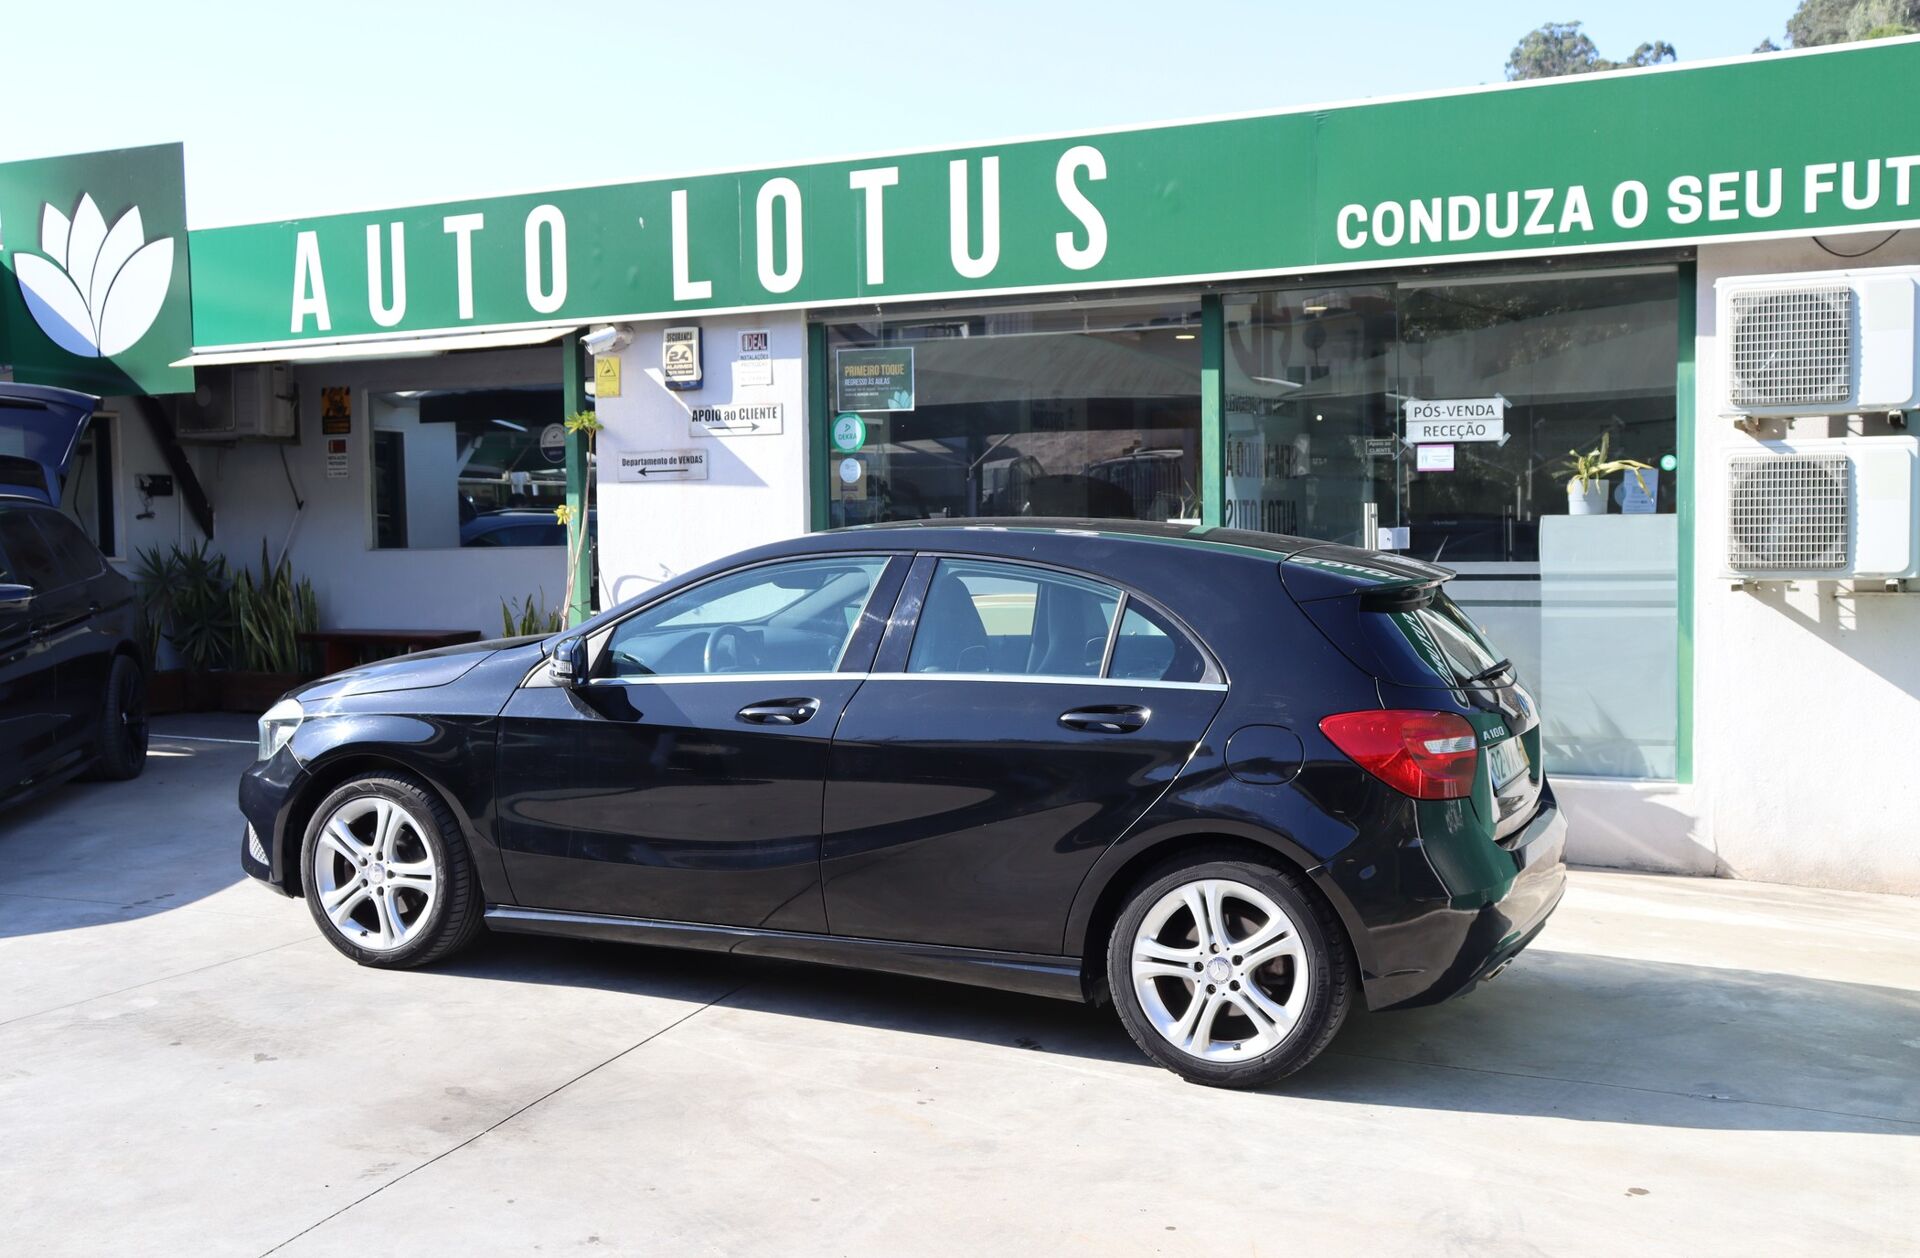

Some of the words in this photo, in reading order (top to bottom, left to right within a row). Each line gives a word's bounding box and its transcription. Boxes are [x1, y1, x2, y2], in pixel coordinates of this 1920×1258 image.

[1336, 186, 1594, 250] CONDUZA
[1611, 179, 1649, 229] O
[1667, 167, 1782, 225] SEU
[1804, 155, 1920, 214] FUT
[291, 204, 567, 334] AUTO
[671, 145, 1107, 301] LOTUS
[669, 350, 689, 362] 24
[844, 365, 880, 377] PRIMEIRO
[881, 363, 905, 376] TOQUE
[844, 378, 868, 386] REGRESSO
[875, 377, 891, 385] AULAS
[692, 408, 721, 422] APOIO
[724, 410, 736, 421] ao
[739, 407, 777, 420] CLIENTE
[1413, 403, 1495, 418] PÓS-VENDA
[1423, 422, 1486, 439] RECEÇÃO
[621, 456, 668, 467] Departamento
[669, 456, 678, 465] de
[678, 455, 703, 465] VENDAS
